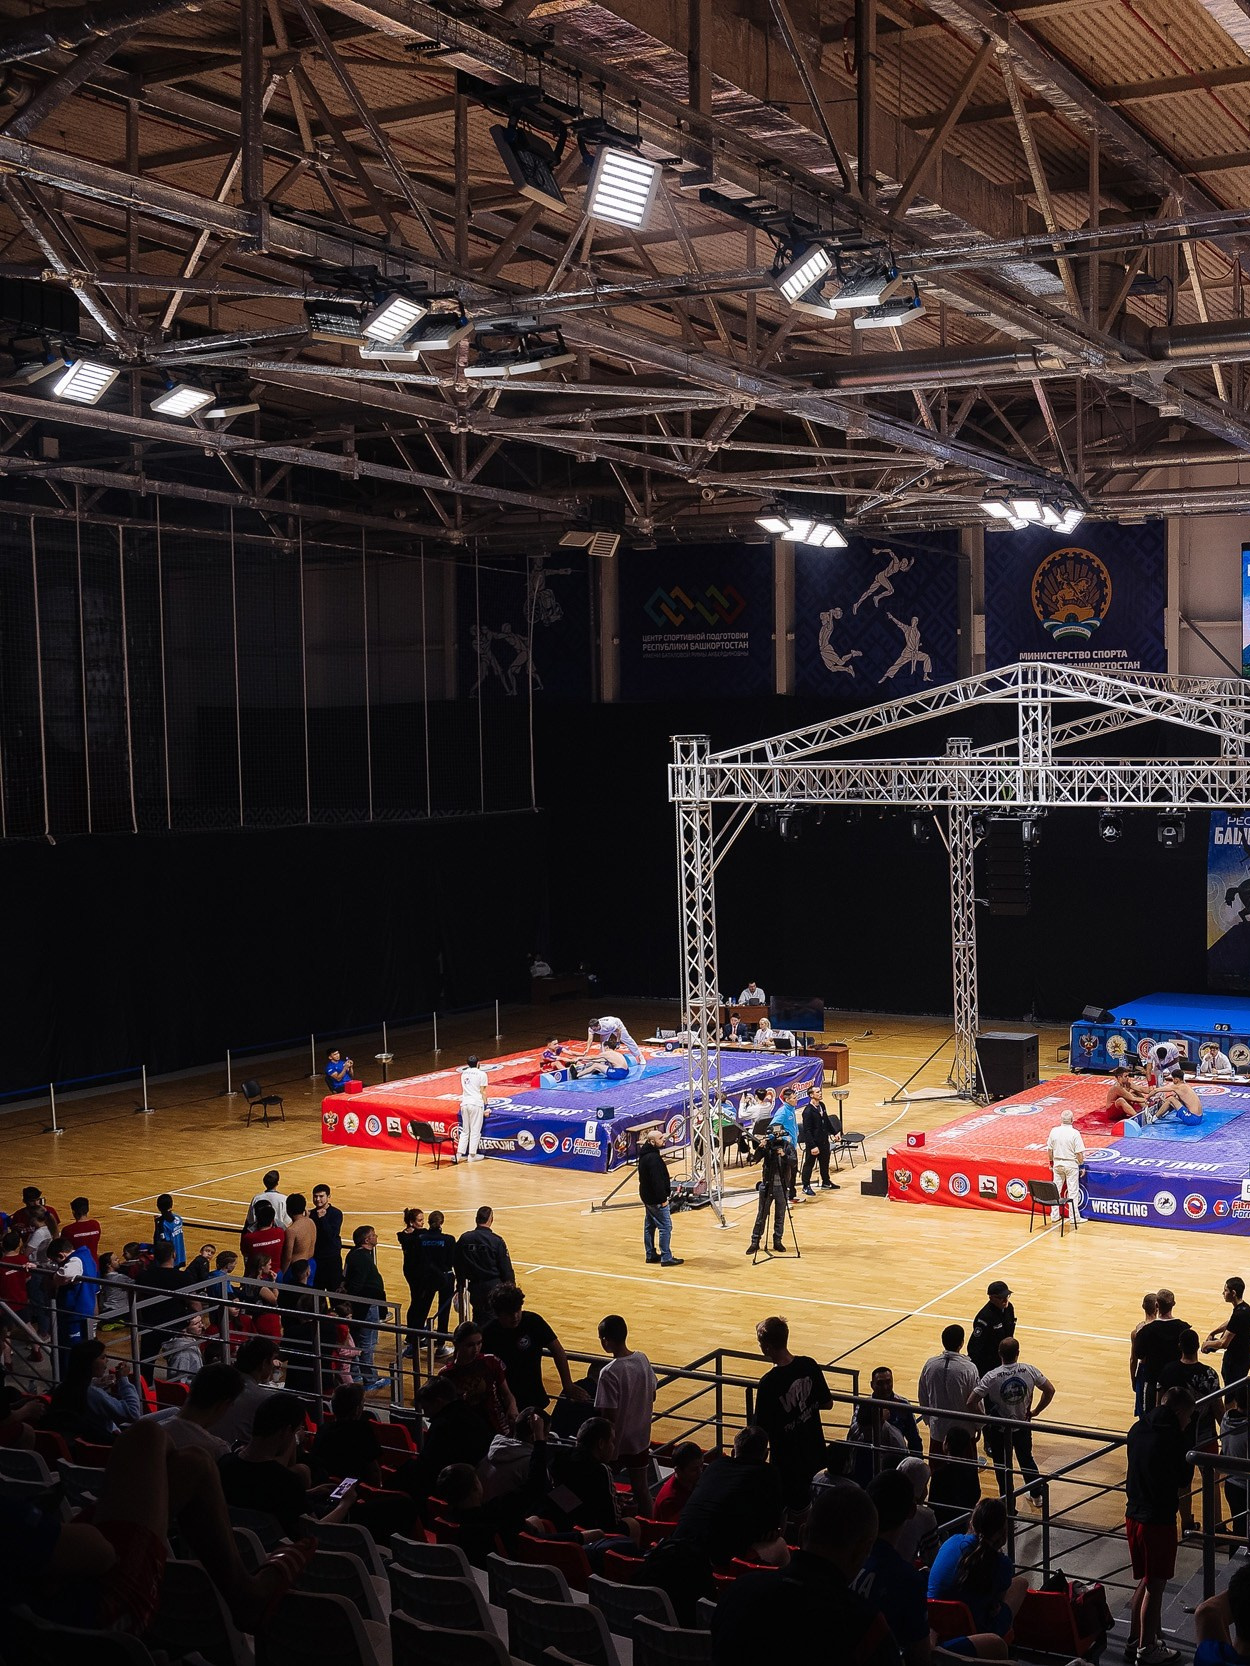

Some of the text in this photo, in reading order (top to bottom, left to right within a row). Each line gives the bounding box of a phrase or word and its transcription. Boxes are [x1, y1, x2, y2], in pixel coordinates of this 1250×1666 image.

[642, 641, 749, 651] РЕСПУБЛИКИ БАШКОРТОСТАН
[1019, 650, 1128, 661] МИНИСТЕРСТВО СПОРТА
[573, 1138, 601, 1149] Fitness
[573, 1146, 602, 1158] Formula
[1114, 1156, 1224, 1172] РЕСТЛИНГ
[1091, 1200, 1148, 1218] WRESTLING
